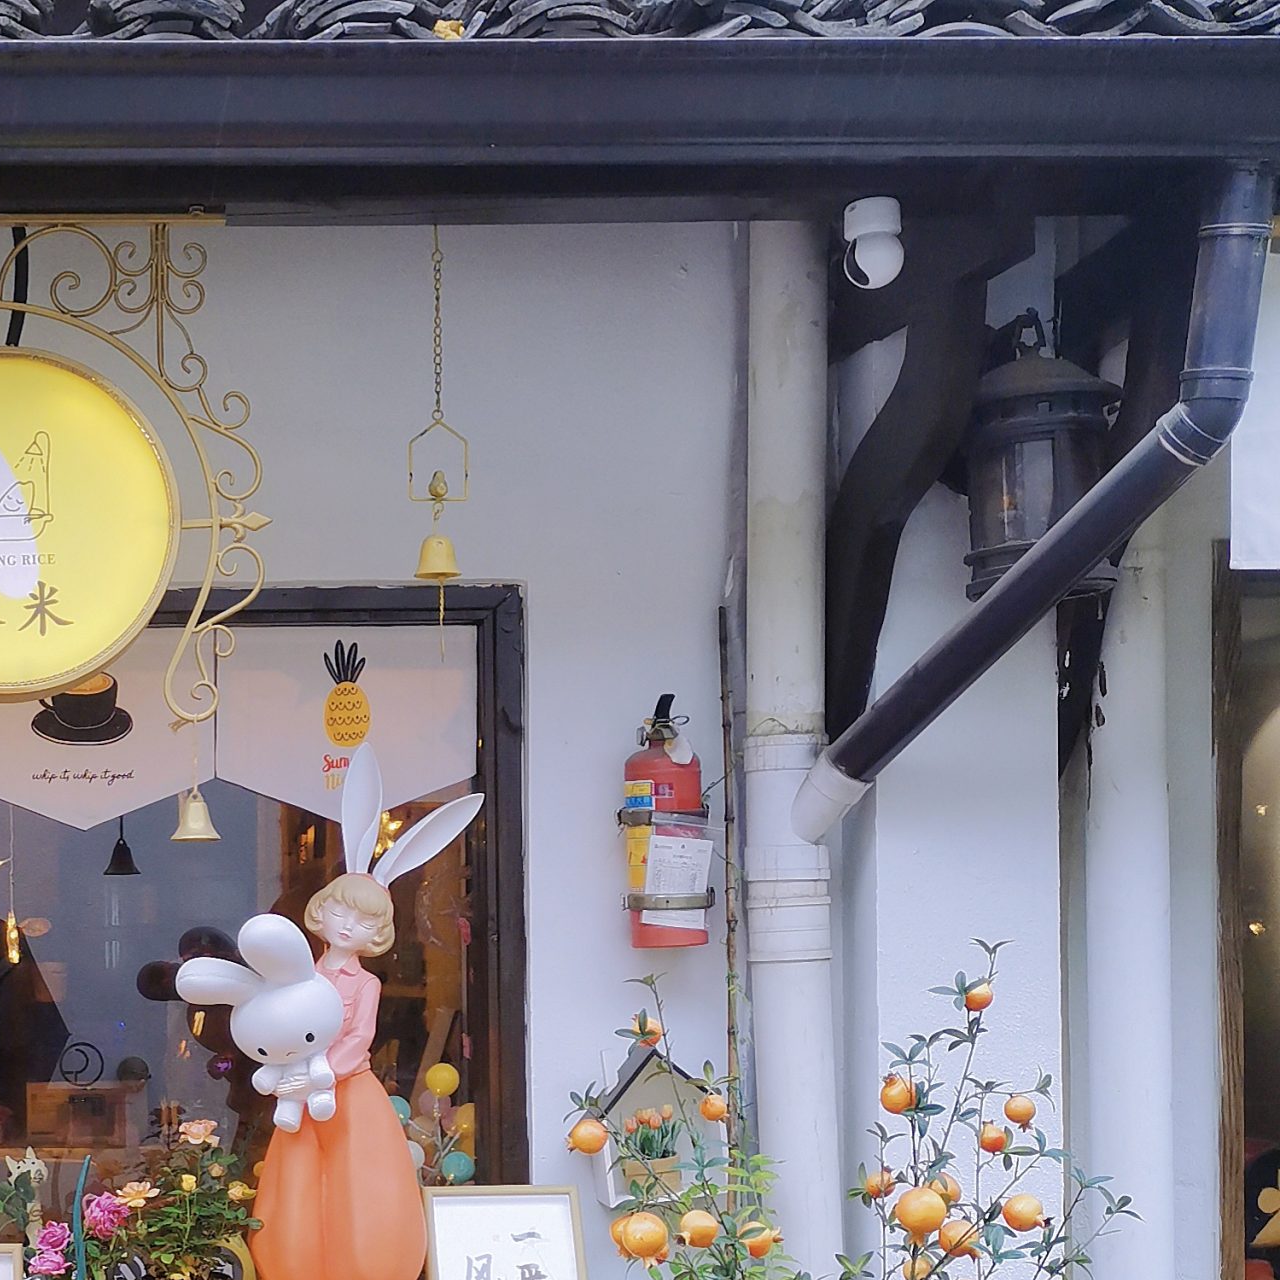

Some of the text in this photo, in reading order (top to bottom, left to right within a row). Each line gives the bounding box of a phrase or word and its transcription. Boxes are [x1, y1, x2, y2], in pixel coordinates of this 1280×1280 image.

[22, 553, 56, 566] RICE
[32, 769, 58, 783] whip
[73, 769, 98, 783] whip
[100, 769, 111, 779] it
[108, 770, 134, 786] good
